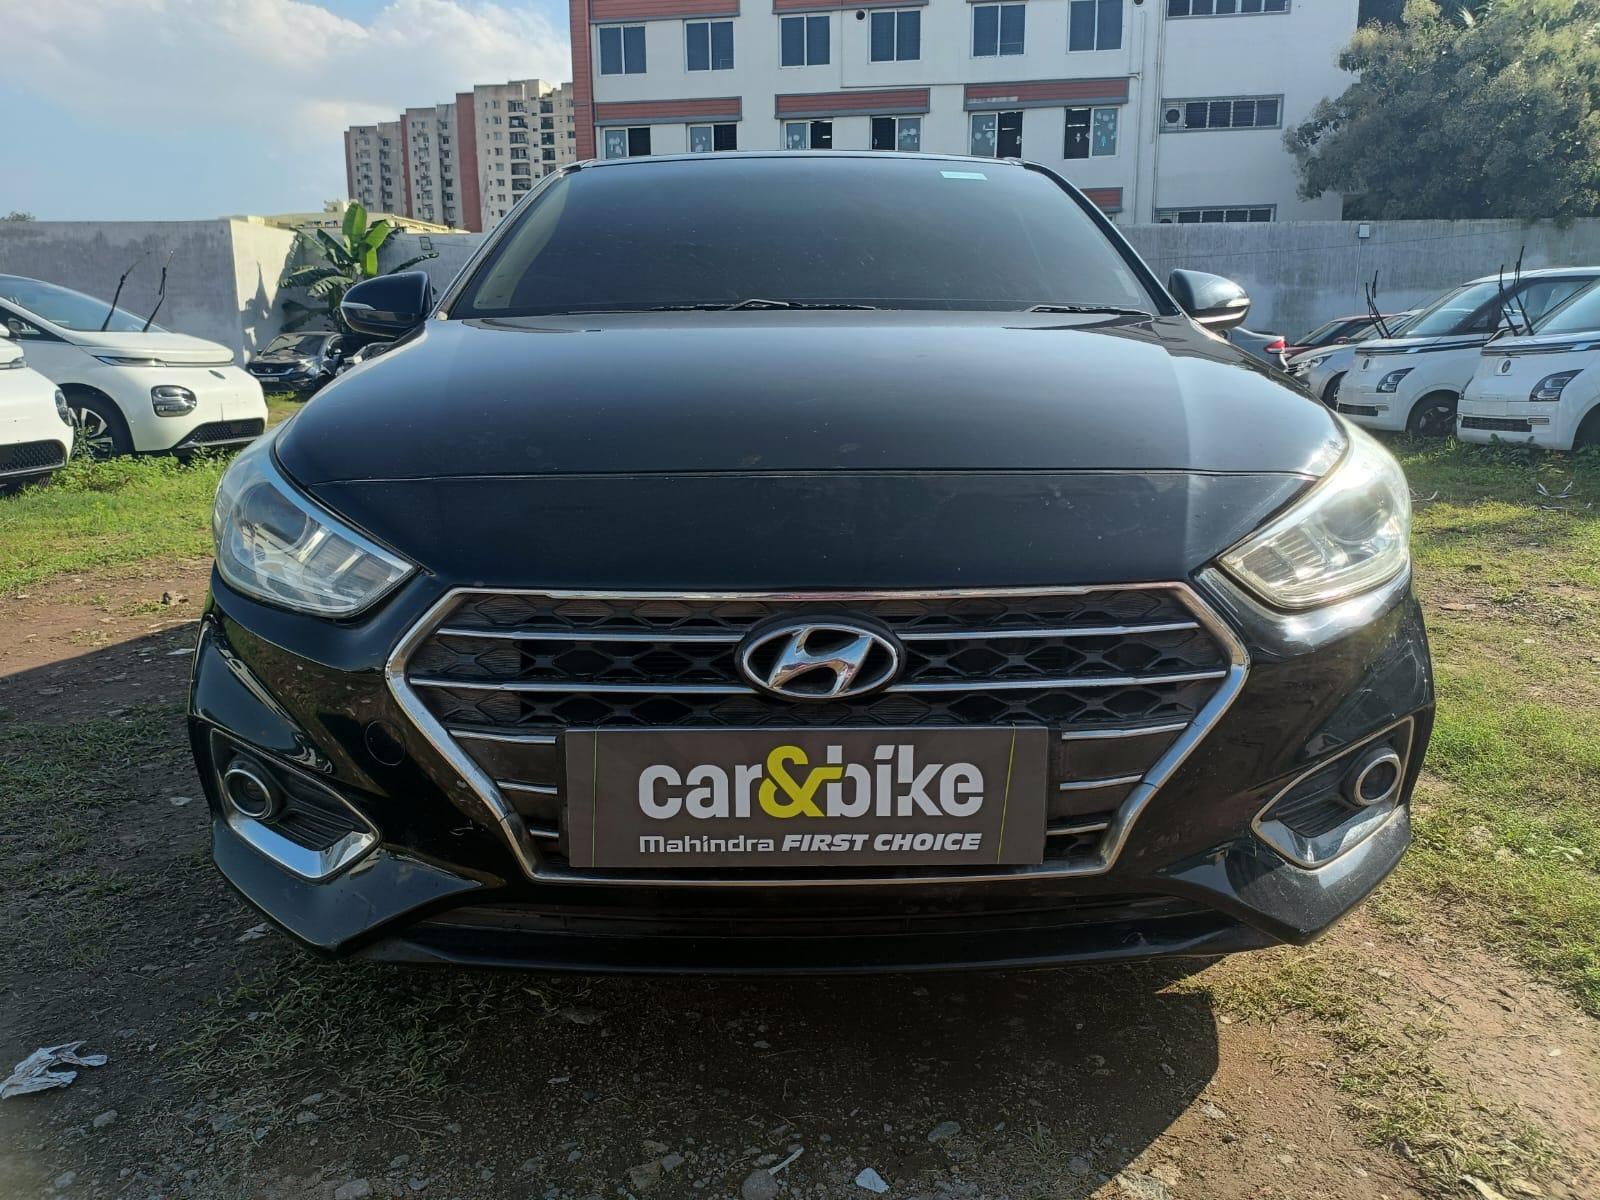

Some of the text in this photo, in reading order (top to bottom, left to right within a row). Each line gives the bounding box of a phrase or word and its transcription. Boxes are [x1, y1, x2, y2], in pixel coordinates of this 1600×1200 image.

[638, 745, 984, 819] car&bike
[639, 833, 982, 853] Mahindra FIRST CHOICE
